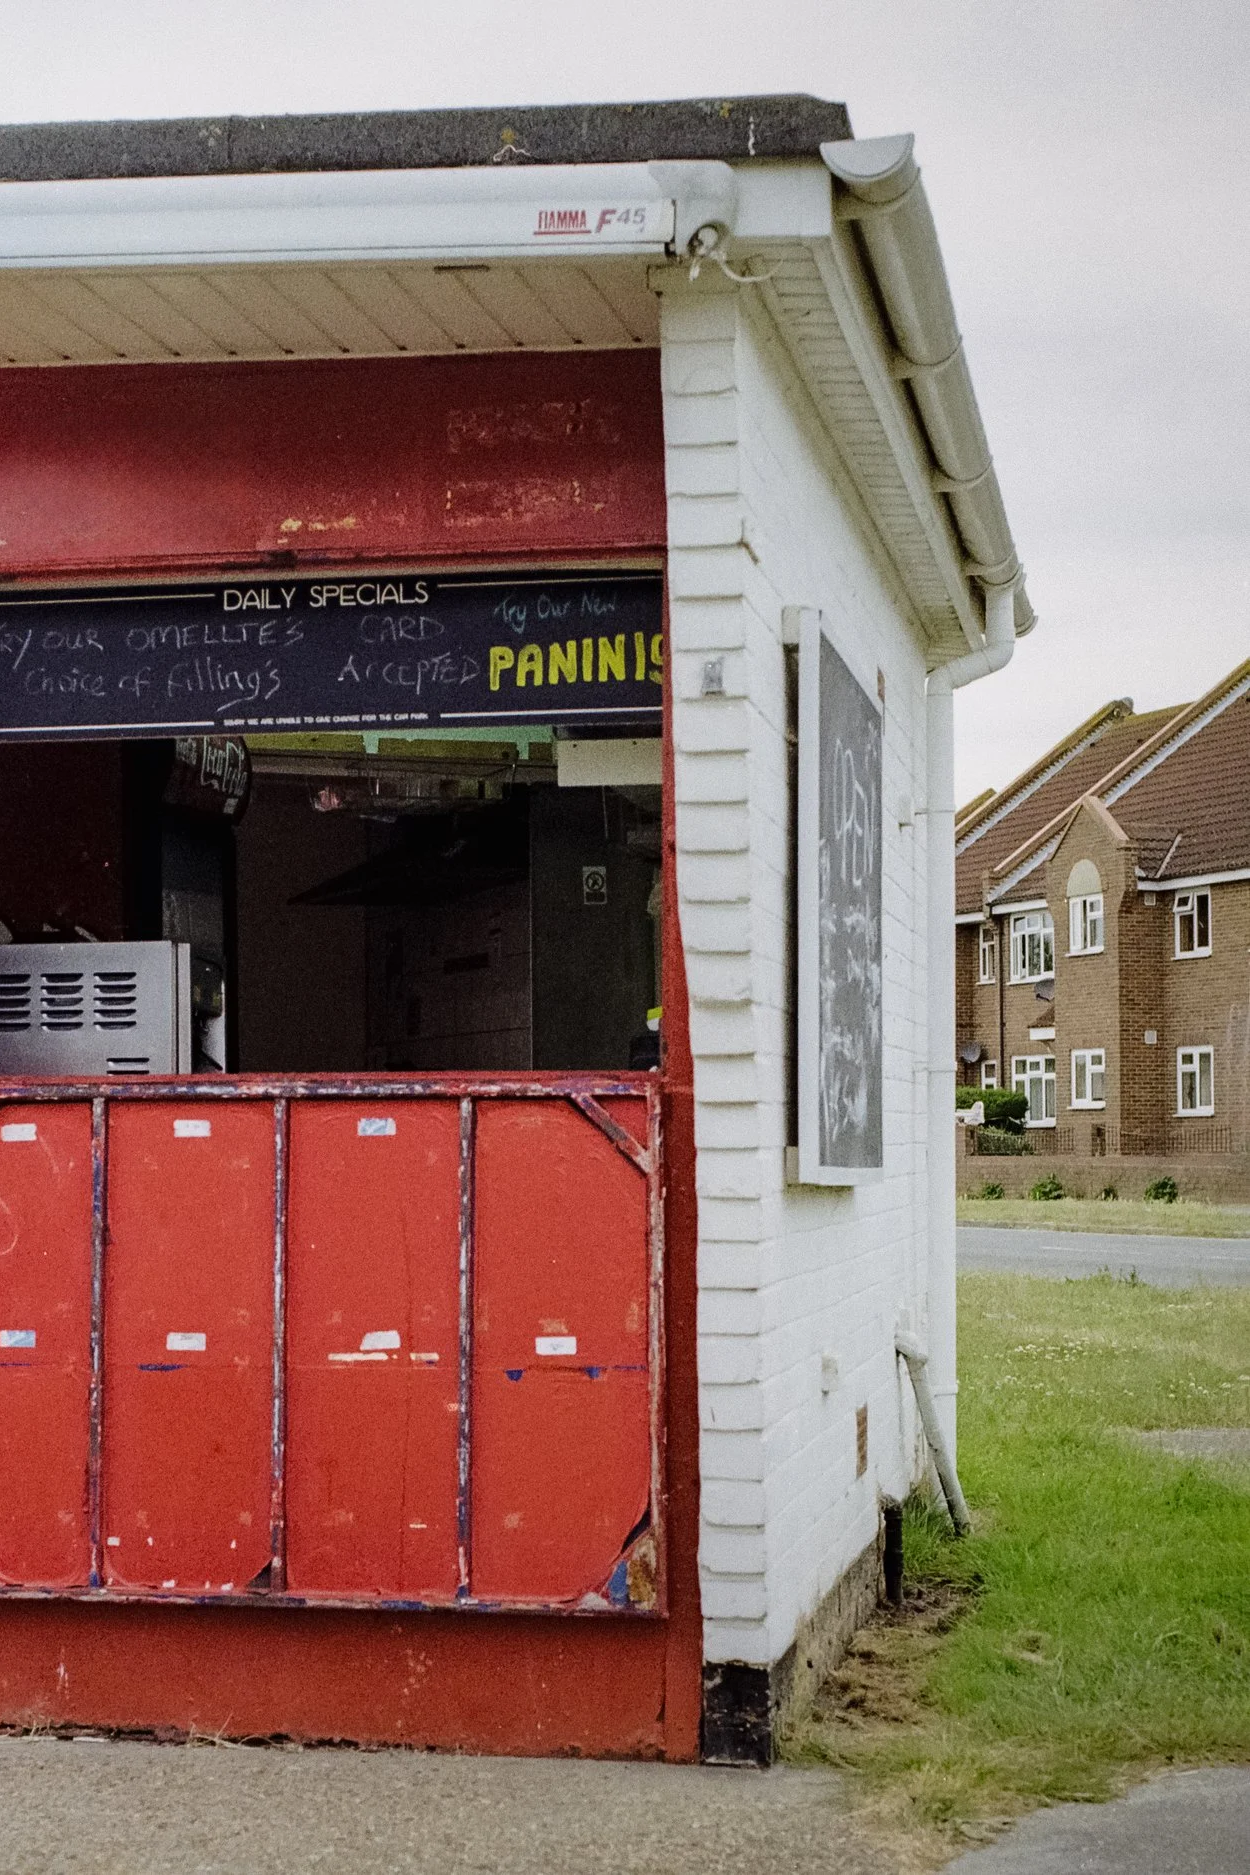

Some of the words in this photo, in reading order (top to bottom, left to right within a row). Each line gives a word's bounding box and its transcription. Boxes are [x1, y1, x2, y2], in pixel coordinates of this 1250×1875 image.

[537, 209, 587, 230] FIAMMA
[223, 587, 296, 612] DAILY
[309, 581, 429, 608] SPECIALS
[303, 716, 314, 724] TO
